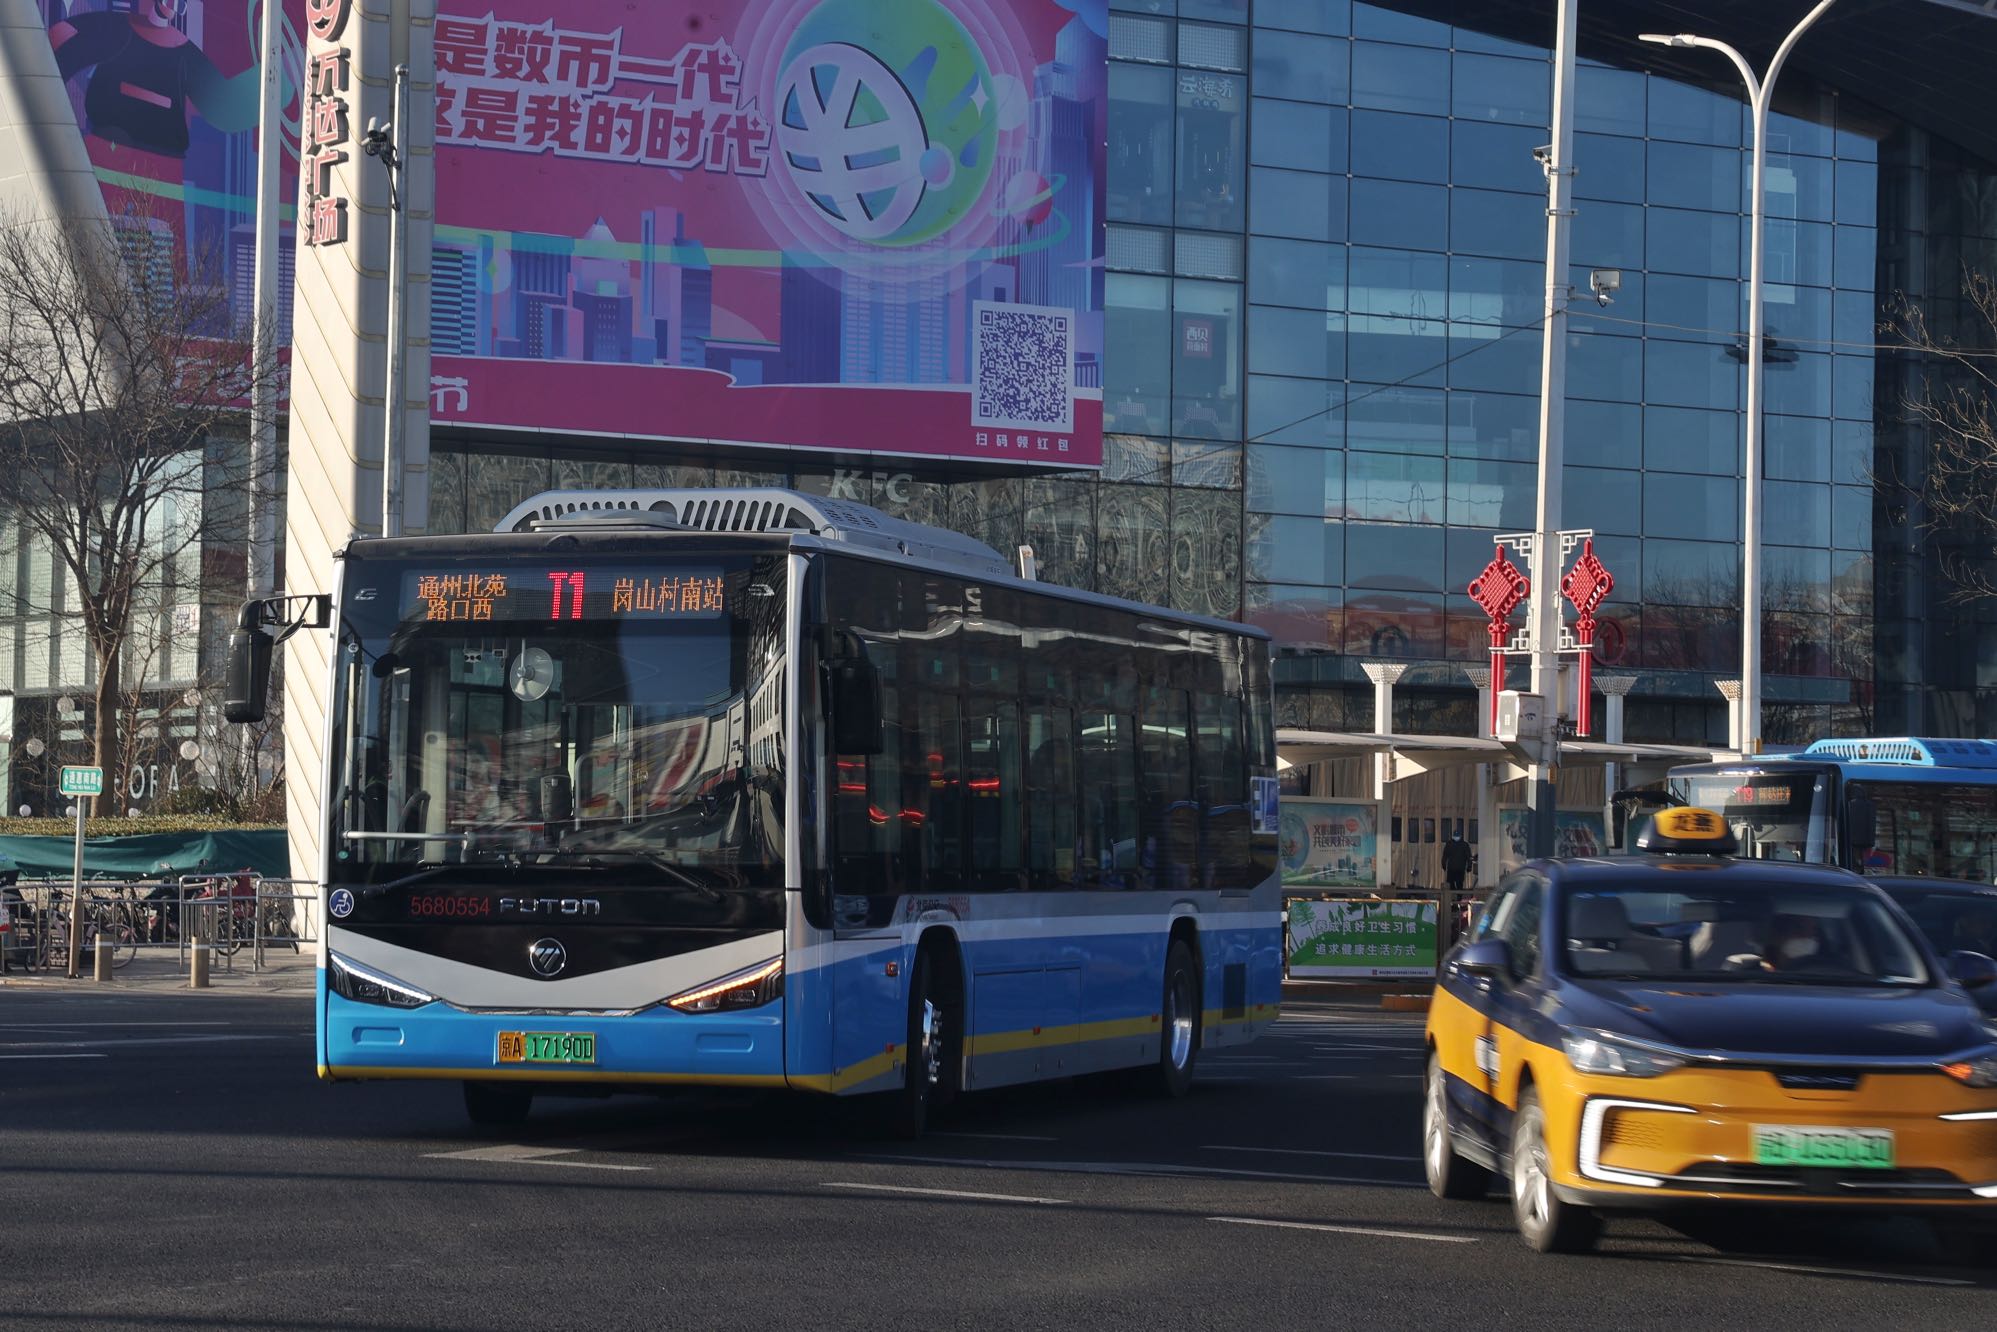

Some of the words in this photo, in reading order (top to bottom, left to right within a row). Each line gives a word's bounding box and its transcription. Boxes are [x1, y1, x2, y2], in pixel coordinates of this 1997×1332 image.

[434, 18, 738, 105] 是数币一代
[312, 49, 342, 246] 万达广场
[975, 431, 1069, 452] 扫码领红包
[827, 468, 913, 503] KFC
[416, 573, 508, 600] 通州北苑
[548, 571, 585, 620] T1
[612, 575, 724, 613] 岗山村南站
[426, 598, 495, 621] 路口西
[411, 896, 491, 916] 5680554
[499, 898, 600, 915] FOTON
[1315, 943, 1417, 957] 追求健康生活方式
